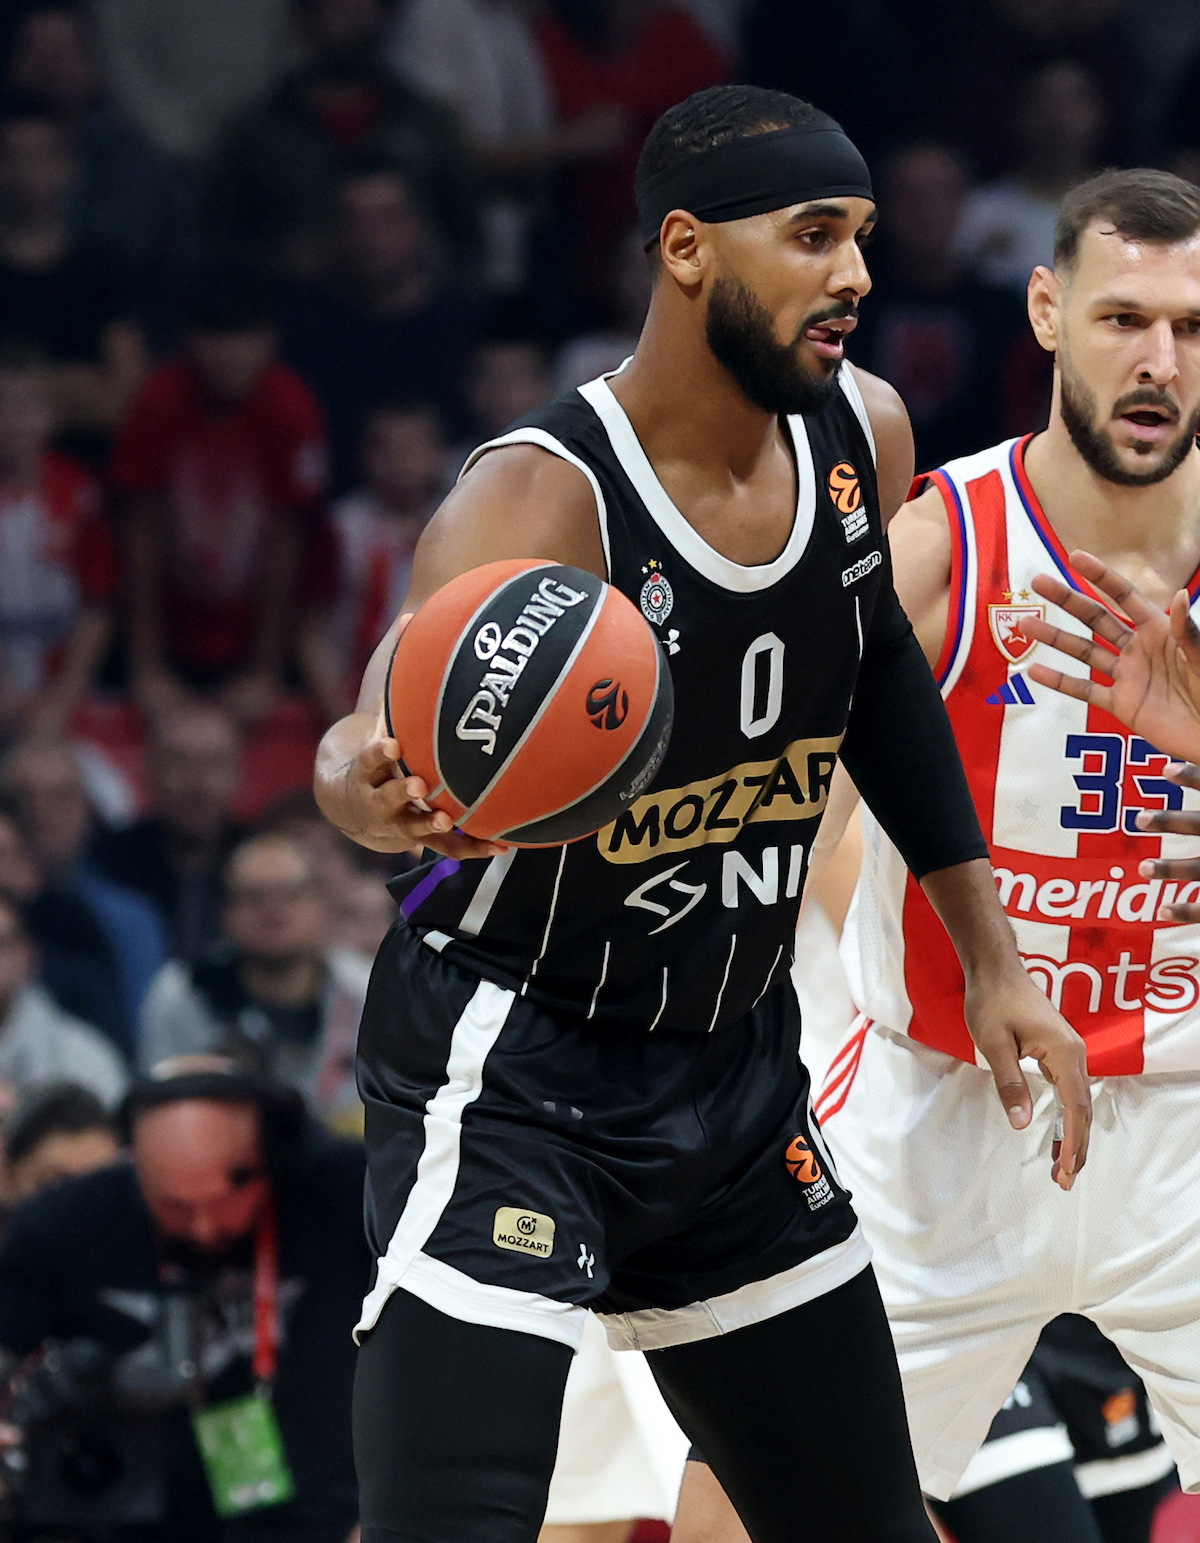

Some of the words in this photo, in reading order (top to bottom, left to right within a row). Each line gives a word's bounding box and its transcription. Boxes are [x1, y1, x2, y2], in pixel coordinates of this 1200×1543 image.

[998, 613, 1013, 622] KK
[456, 577, 589, 755] SPALDING
[740, 631, 785, 739] 0
[608, 752, 839, 852] MOZZAR
[1060, 733, 1186, 833] 33
[722, 844, 804, 908] NI
[1017, 951, 1200, 1014] mts
[497, 1234, 549, 1253] MOZZART
